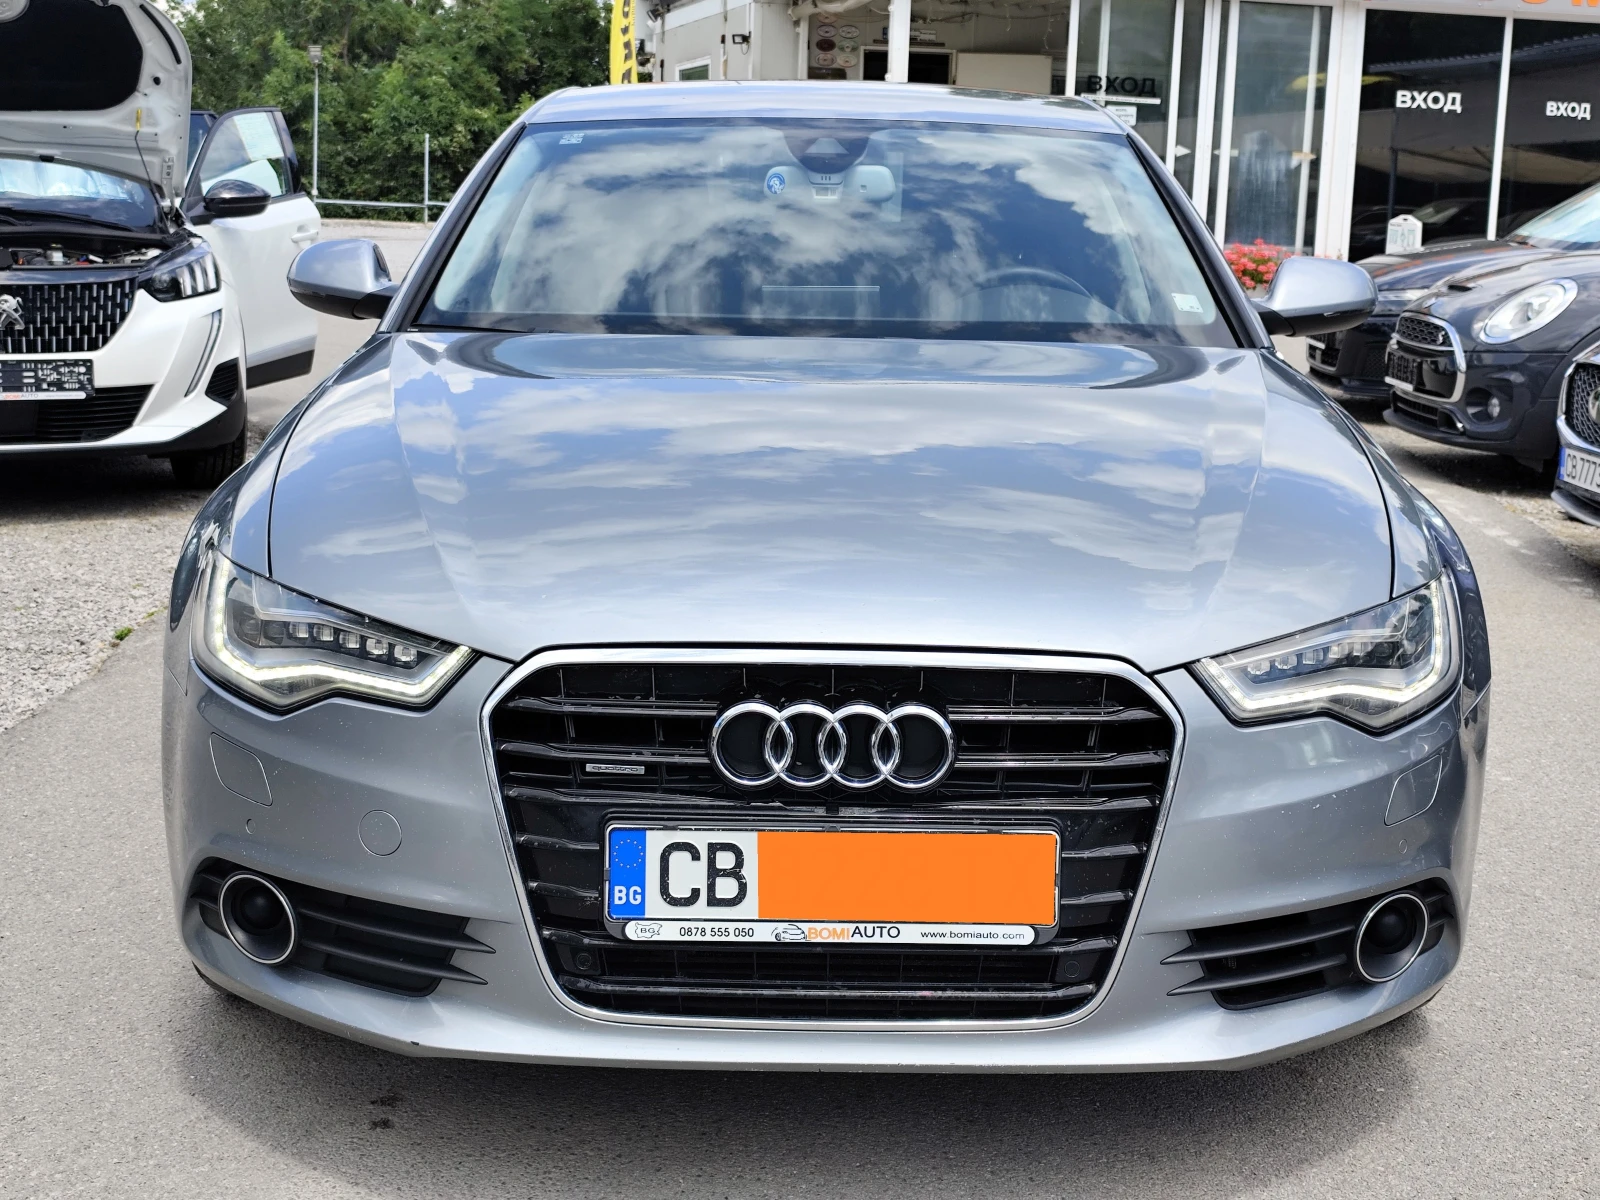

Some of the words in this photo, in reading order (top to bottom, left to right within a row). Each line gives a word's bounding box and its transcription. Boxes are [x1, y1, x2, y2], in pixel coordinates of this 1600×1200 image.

[1087, 75, 1156, 97] ВХОД
[1395, 90, 1462, 113] ВХОД
[1545, 101, 1591, 120] ВХОД
[659, 841, 748, 907] CB
[613, 885, 642, 905] BG
[679, 926, 707, 937] 0878
[710, 927, 730, 937] 555
[733, 927, 755, 938] 050
[920, 930, 1025, 940] www.bomiauto.com
